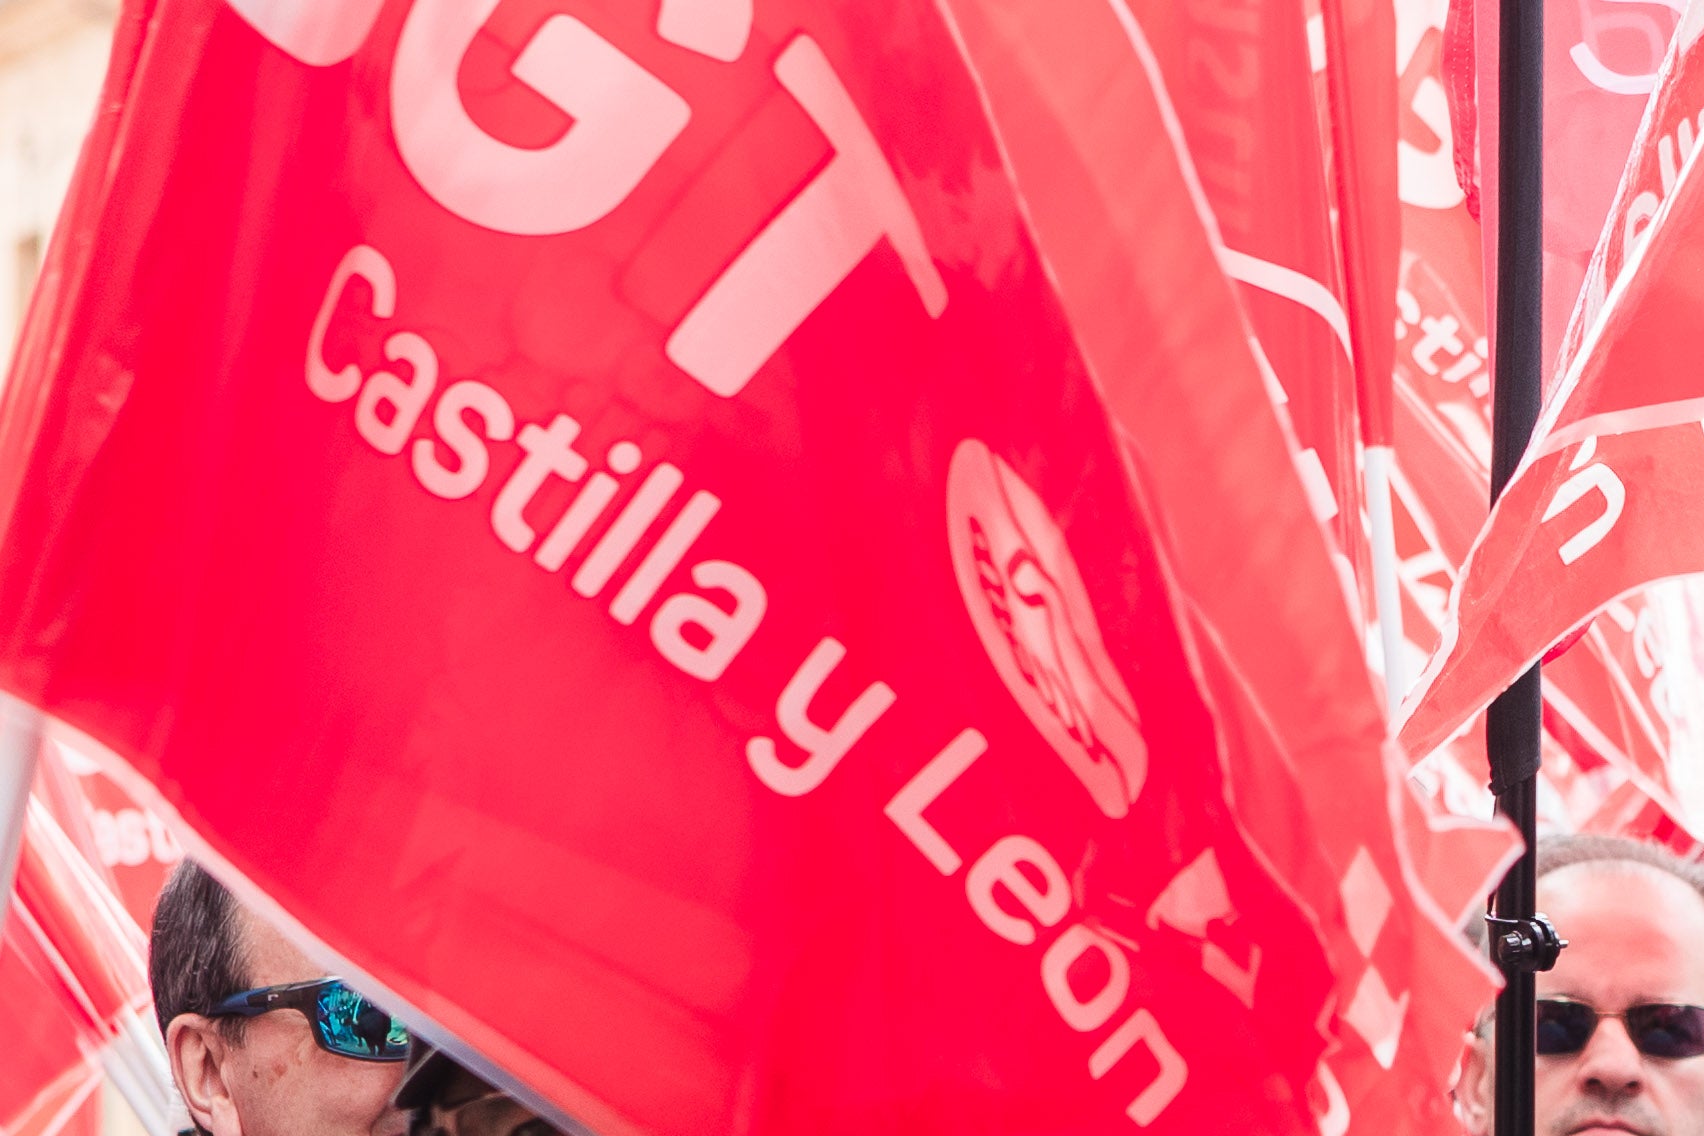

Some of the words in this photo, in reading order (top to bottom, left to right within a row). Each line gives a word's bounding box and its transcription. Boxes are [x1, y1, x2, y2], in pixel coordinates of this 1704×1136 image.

[225, 0, 949, 398] GT
[304, 244, 768, 682] Castilla
[745, 637, 896, 797] y
[884, 727, 1188, 1127] León
